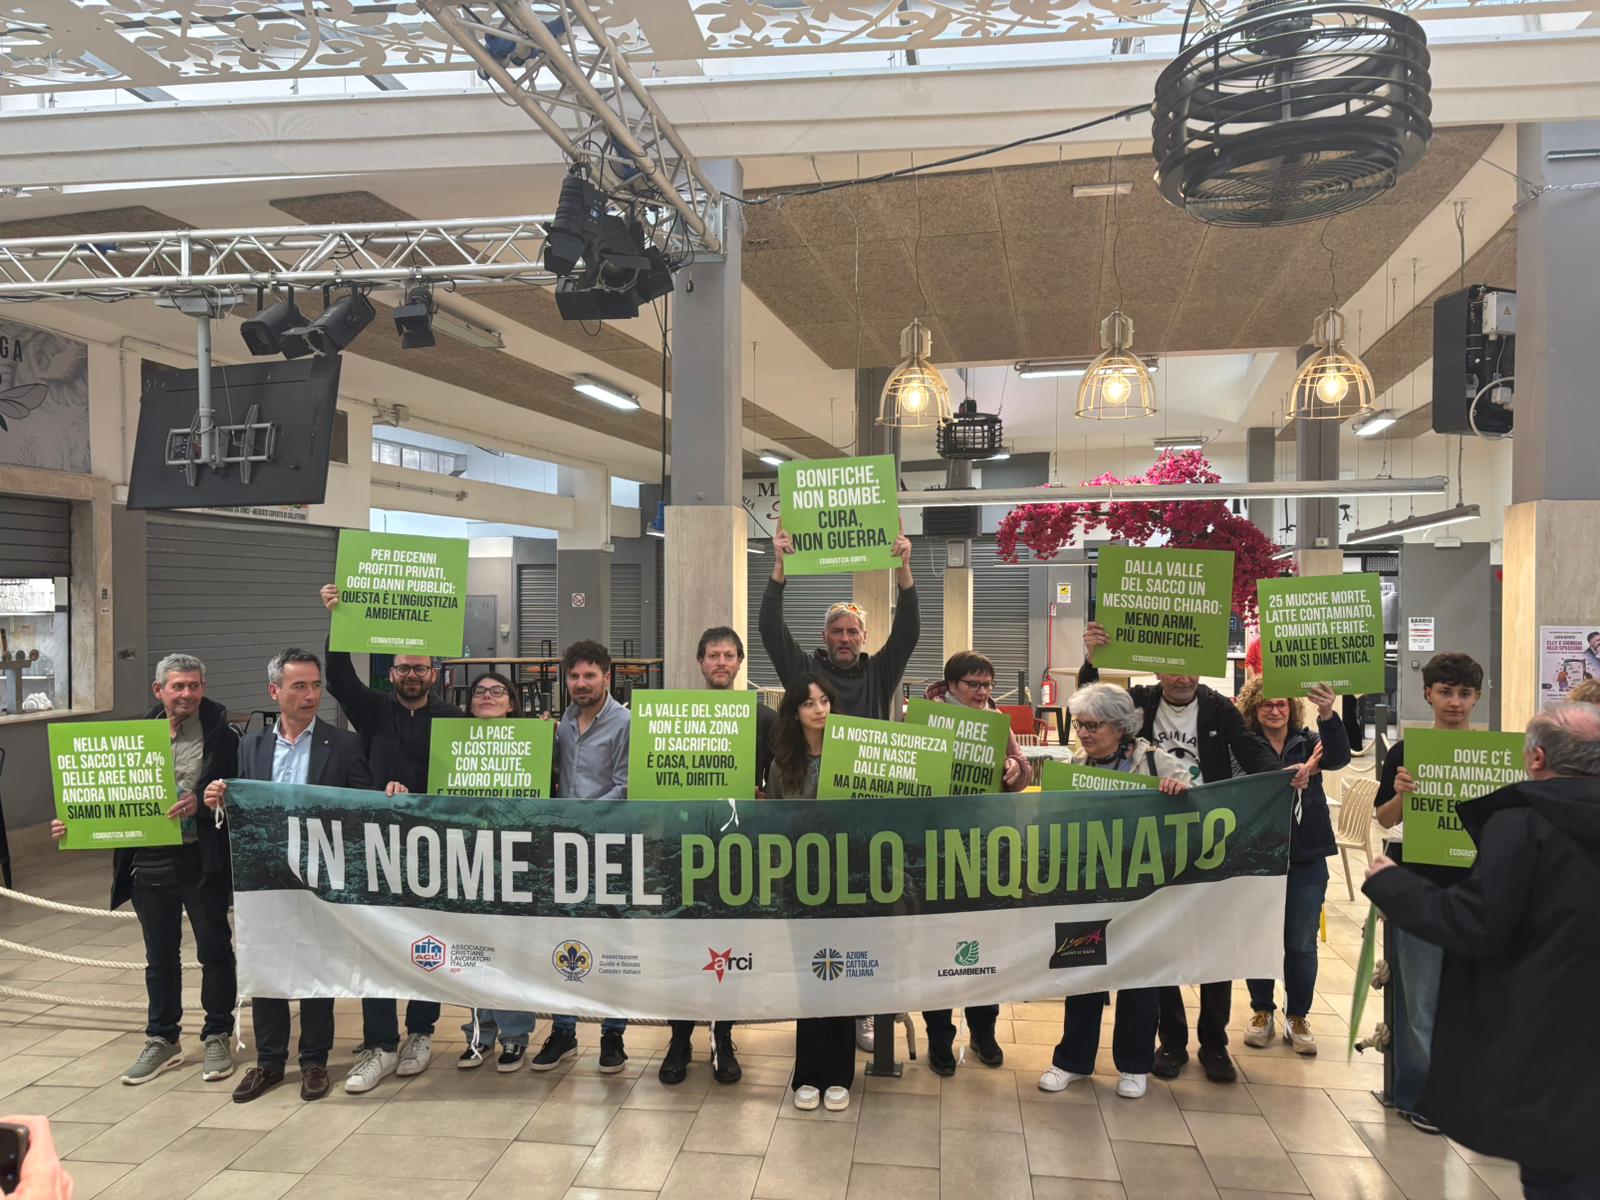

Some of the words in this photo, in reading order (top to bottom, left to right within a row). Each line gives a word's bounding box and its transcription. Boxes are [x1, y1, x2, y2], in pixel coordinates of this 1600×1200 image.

[796, 465, 879, 488] BONIFICHE,
[793, 490, 823, 510] NON
[828, 486, 885, 507] BOMBE.
[818, 509, 863, 529] CURA,
[792, 533, 823, 552] NON
[827, 528, 892, 550] GUERRA.
[371, 548, 391, 561] PER
[393, 550, 437, 564] DECENNI
[358, 562, 403, 576] PROFITTI
[1125, 559, 1162, 576] DALLA
[1166, 561, 1204, 578] VALLE
[347, 576, 370, 589] OGGI
[373, 577, 404, 591] DANNI
[407, 580, 456, 594] PUBBLICI:
[1121, 576, 1143, 592] DEL
[1146, 578, 1185, 595] SACCO
[1189, 581, 1206, 596] UN
[341, 591, 380, 604] QUESTA
[383, 590, 389, 605] È
[392, 592, 458, 608] L'INGIUSTIZIA
[1103, 592, 1171, 611] MESSAGGIO
[1174, 597, 1223, 615] CHIARO:
[1269, 595, 1283, 608] 25
[1286, 592, 1329, 607] MUCCHE
[1331, 590, 1370, 604] MORTE,
[365, 607, 432, 622] AMBIENTALE.
[1125, 611, 1159, 627] MENO
[1162, 614, 1196, 632] ARMI,
[1266, 609, 1297, 623] LATTE
[1300, 604, 1375, 621] CONTAMINATO,
[1116, 626, 1135, 642] PIÙ
[1138, 630, 1204, 648] BONIFICHE.
[1275, 620, 1328, 638] COMUNITÀ
[1330, 620, 1369, 635] FERITE:
[371, 636, 405, 645] ECOGIUSTIZIA
[1269, 640, 1283, 653] LA
[1286, 638, 1318, 652] VALLE
[1320, 637, 1340, 651] DEL
[1342, 635, 1375, 649] SACCO
[1132, 655, 1165, 664] ECOGIUSTIZIA
[1275, 655, 1298, 668] NON
[1300, 654, 1310, 667] SI
[1313, 651, 1371, 665] DIMENTICA.
[639, 703, 653, 717] LA
[655, 703, 689, 718] VALLE
[691, 704, 711, 718] DEL
[714, 704, 750, 718] SACCO
[470, 726, 483, 739] LA
[487, 726, 515, 740] PACE
[648, 720, 672, 734] NON
[674, 717, 681, 734] È
[684, 721, 707, 734] UNA
[709, 721, 738, 734] ZONA
[927, 714, 955, 731] NON
[956, 720, 989, 742] AREE
[73, 736, 108, 752] NELLA
[110, 735, 144, 751] VALLE
[654, 737, 666, 751] DI
[668, 737, 732, 752] SACRIFICIO:
[831, 725, 845, 740] LA
[847, 727, 888, 744] NOSTRA
[890, 732, 948, 753] SICUREZZA
[451, 741, 461, 756] SI
[464, 741, 532, 756] COSTRUISCE
[858, 745, 880, 760] NON
[882, 748, 918, 765] NASCE
[952, 742, 996, 768] RIFICIO,
[1454, 748, 1488, 765] DOVE
[1491, 748, 1512, 766] C'È
[57, 754, 78, 770] DEL
[81, 753, 116, 768] SACCO
[119, 752, 165, 769] L'87,4%
[455, 757, 478, 771] CON
[480, 757, 525, 773] SALUTE,
[647, 752, 654, 768] È
[656, 754, 689, 770] CASA,
[692, 755, 738, 770] LAVORO,
[62, 771, 96, 786] DELLE
[98, 769, 127, 785] AREE
[129, 768, 152, 784] NON
[156, 765, 163, 783] È
[448, 773, 491, 787] LAVORO
[493, 773, 532, 787] PULITO
[656, 772, 683, 788] VITA,
[686, 772, 728, 786] DIRITTI.
[853, 760, 886, 777] DALLE
[888, 764, 919, 782] ARMI,
[62, 788, 106, 803] ANCORA
[108, 786, 168, 801] INDAGATO:
[833, 774, 850, 788] MA
[852, 776, 867, 790] DA
[870, 777, 894, 794] ARIA
[897, 782, 932, 797] PULITA
[1412, 780, 1456, 798] SUOLO,
[1460, 783, 1501, 798] ACQU
[67, 805, 102, 819] SIAMO
[104, 804, 115, 819] IN
[119, 802, 165, 818] ATTESA.
[1411, 797, 1444, 813] DEVE
[92, 831, 124, 839] ECOGIUSTIZIA
[287, 815, 346, 891] IN
[363, 822, 533, 904] NOME
[553, 831, 663, 907] DEL
[680, 830, 905, 907] POPOLO
[925, 807, 1237, 901] INQUINATO
[1449, 848, 1477, 858] ECOGIUS
[714, 953, 753, 971] arci
[845, 951, 869, 960] AZIONE
[845, 959, 880, 968] CATTOLICA
[845, 968, 874, 977] ITALIANA
[937, 966, 996, 977] LEGAMBIENTE
